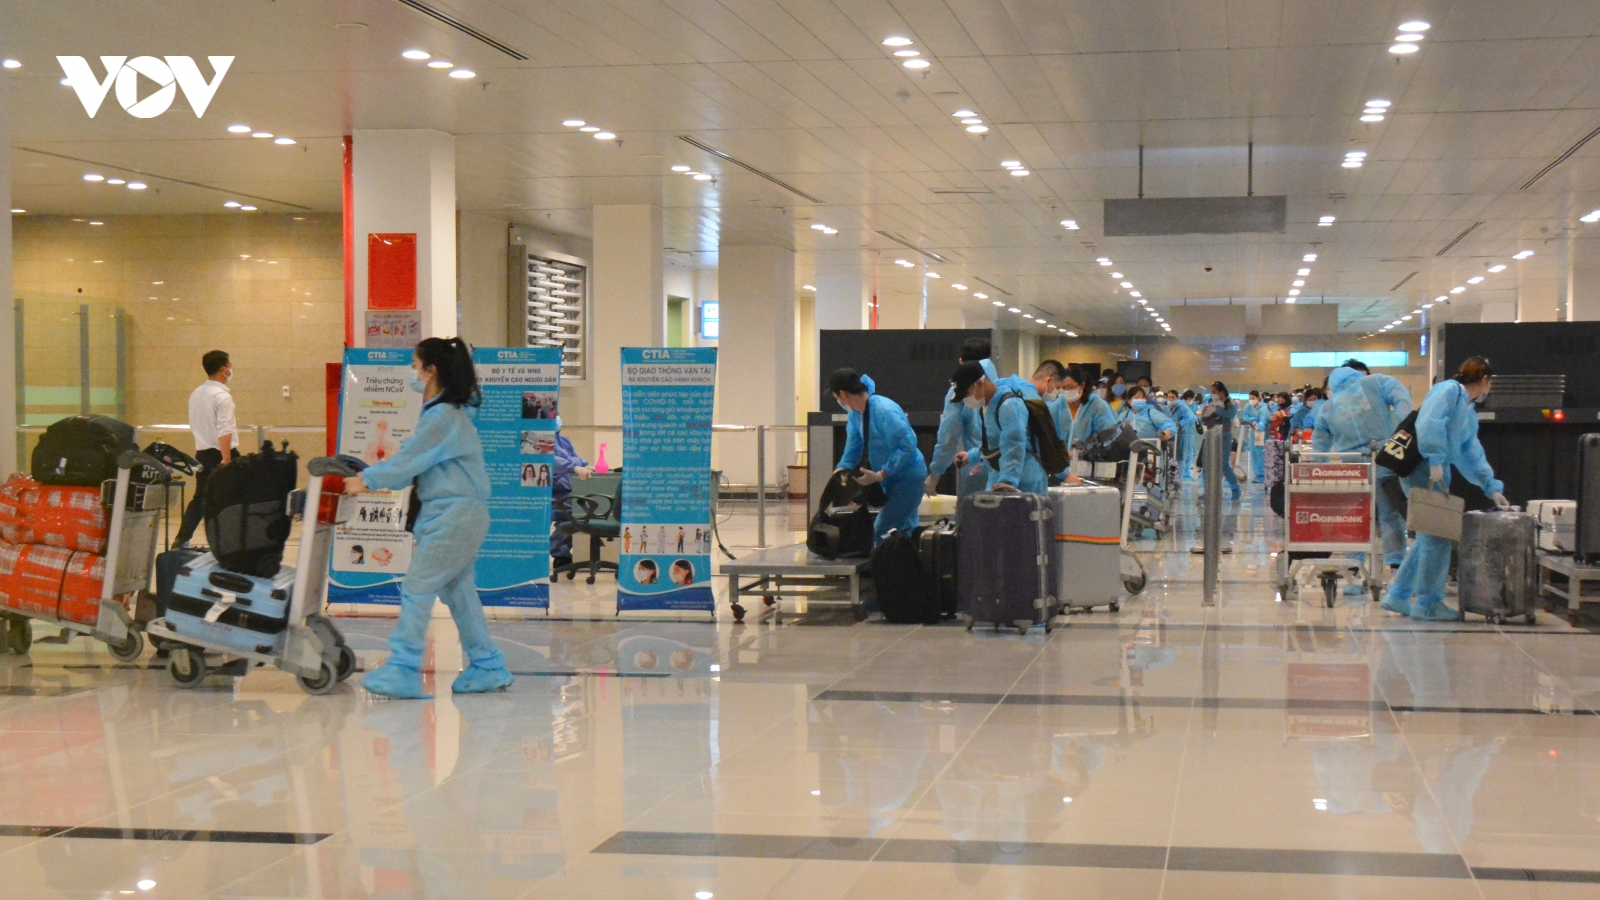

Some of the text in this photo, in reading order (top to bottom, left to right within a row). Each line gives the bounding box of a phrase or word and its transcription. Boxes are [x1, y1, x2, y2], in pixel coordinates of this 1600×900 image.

[368, 351, 387, 359] CTIA
[498, 351, 518, 359] CTIA
[642, 349, 671, 359] CTIA
[1384, 430, 1412, 460] FILA
[1311, 467, 1362, 477] AGRIBANK
[1309, 513, 1363, 523] AGRIBANK
